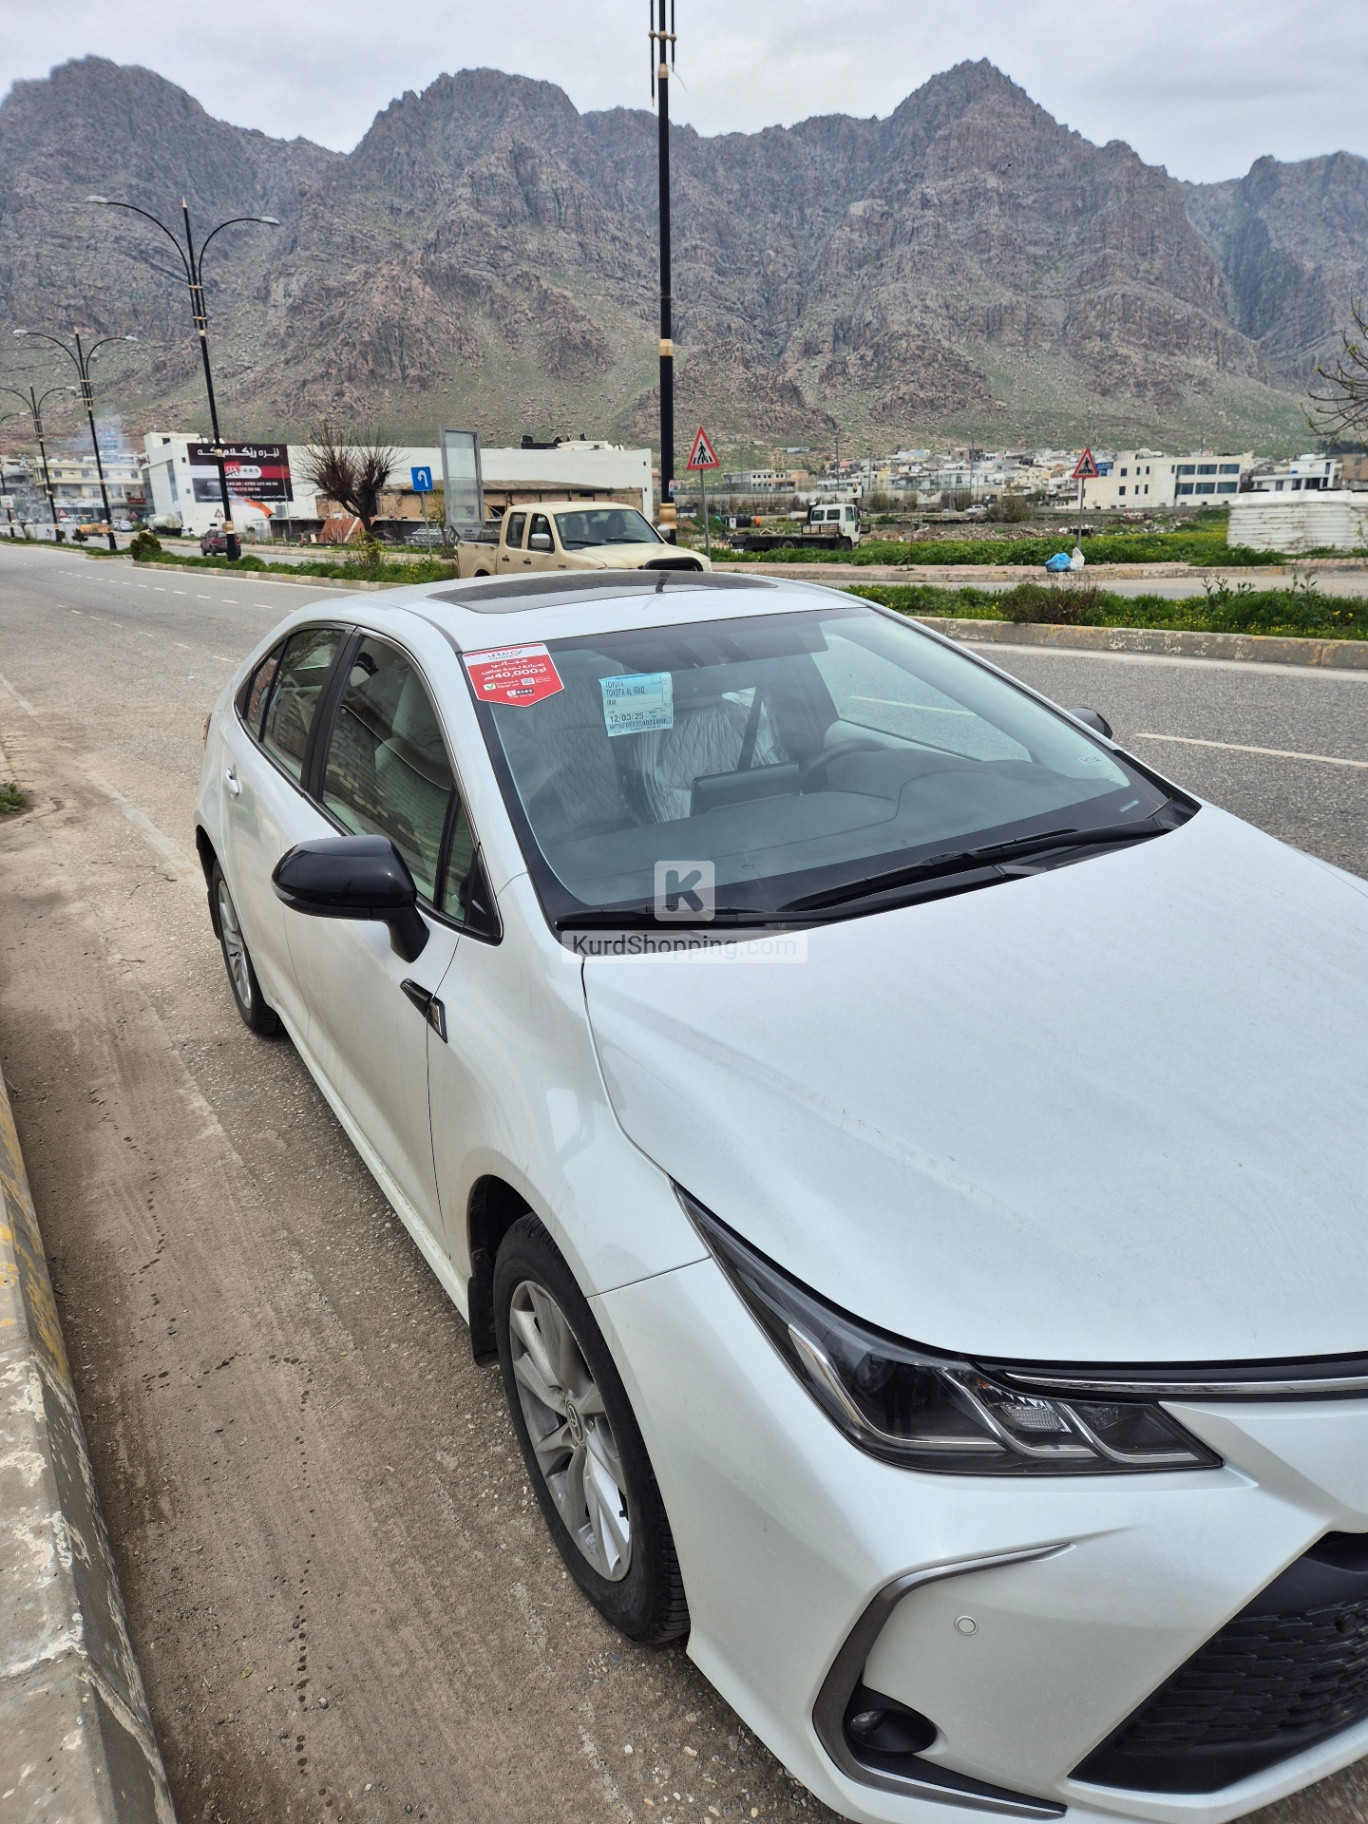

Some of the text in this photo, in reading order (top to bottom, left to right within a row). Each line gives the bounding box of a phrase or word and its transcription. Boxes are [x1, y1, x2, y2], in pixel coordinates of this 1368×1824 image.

[495, 668, 538, 679] 40,000
[606, 688, 625, 697] TOYOTA
[609, 712, 644, 723] 12/03/25
